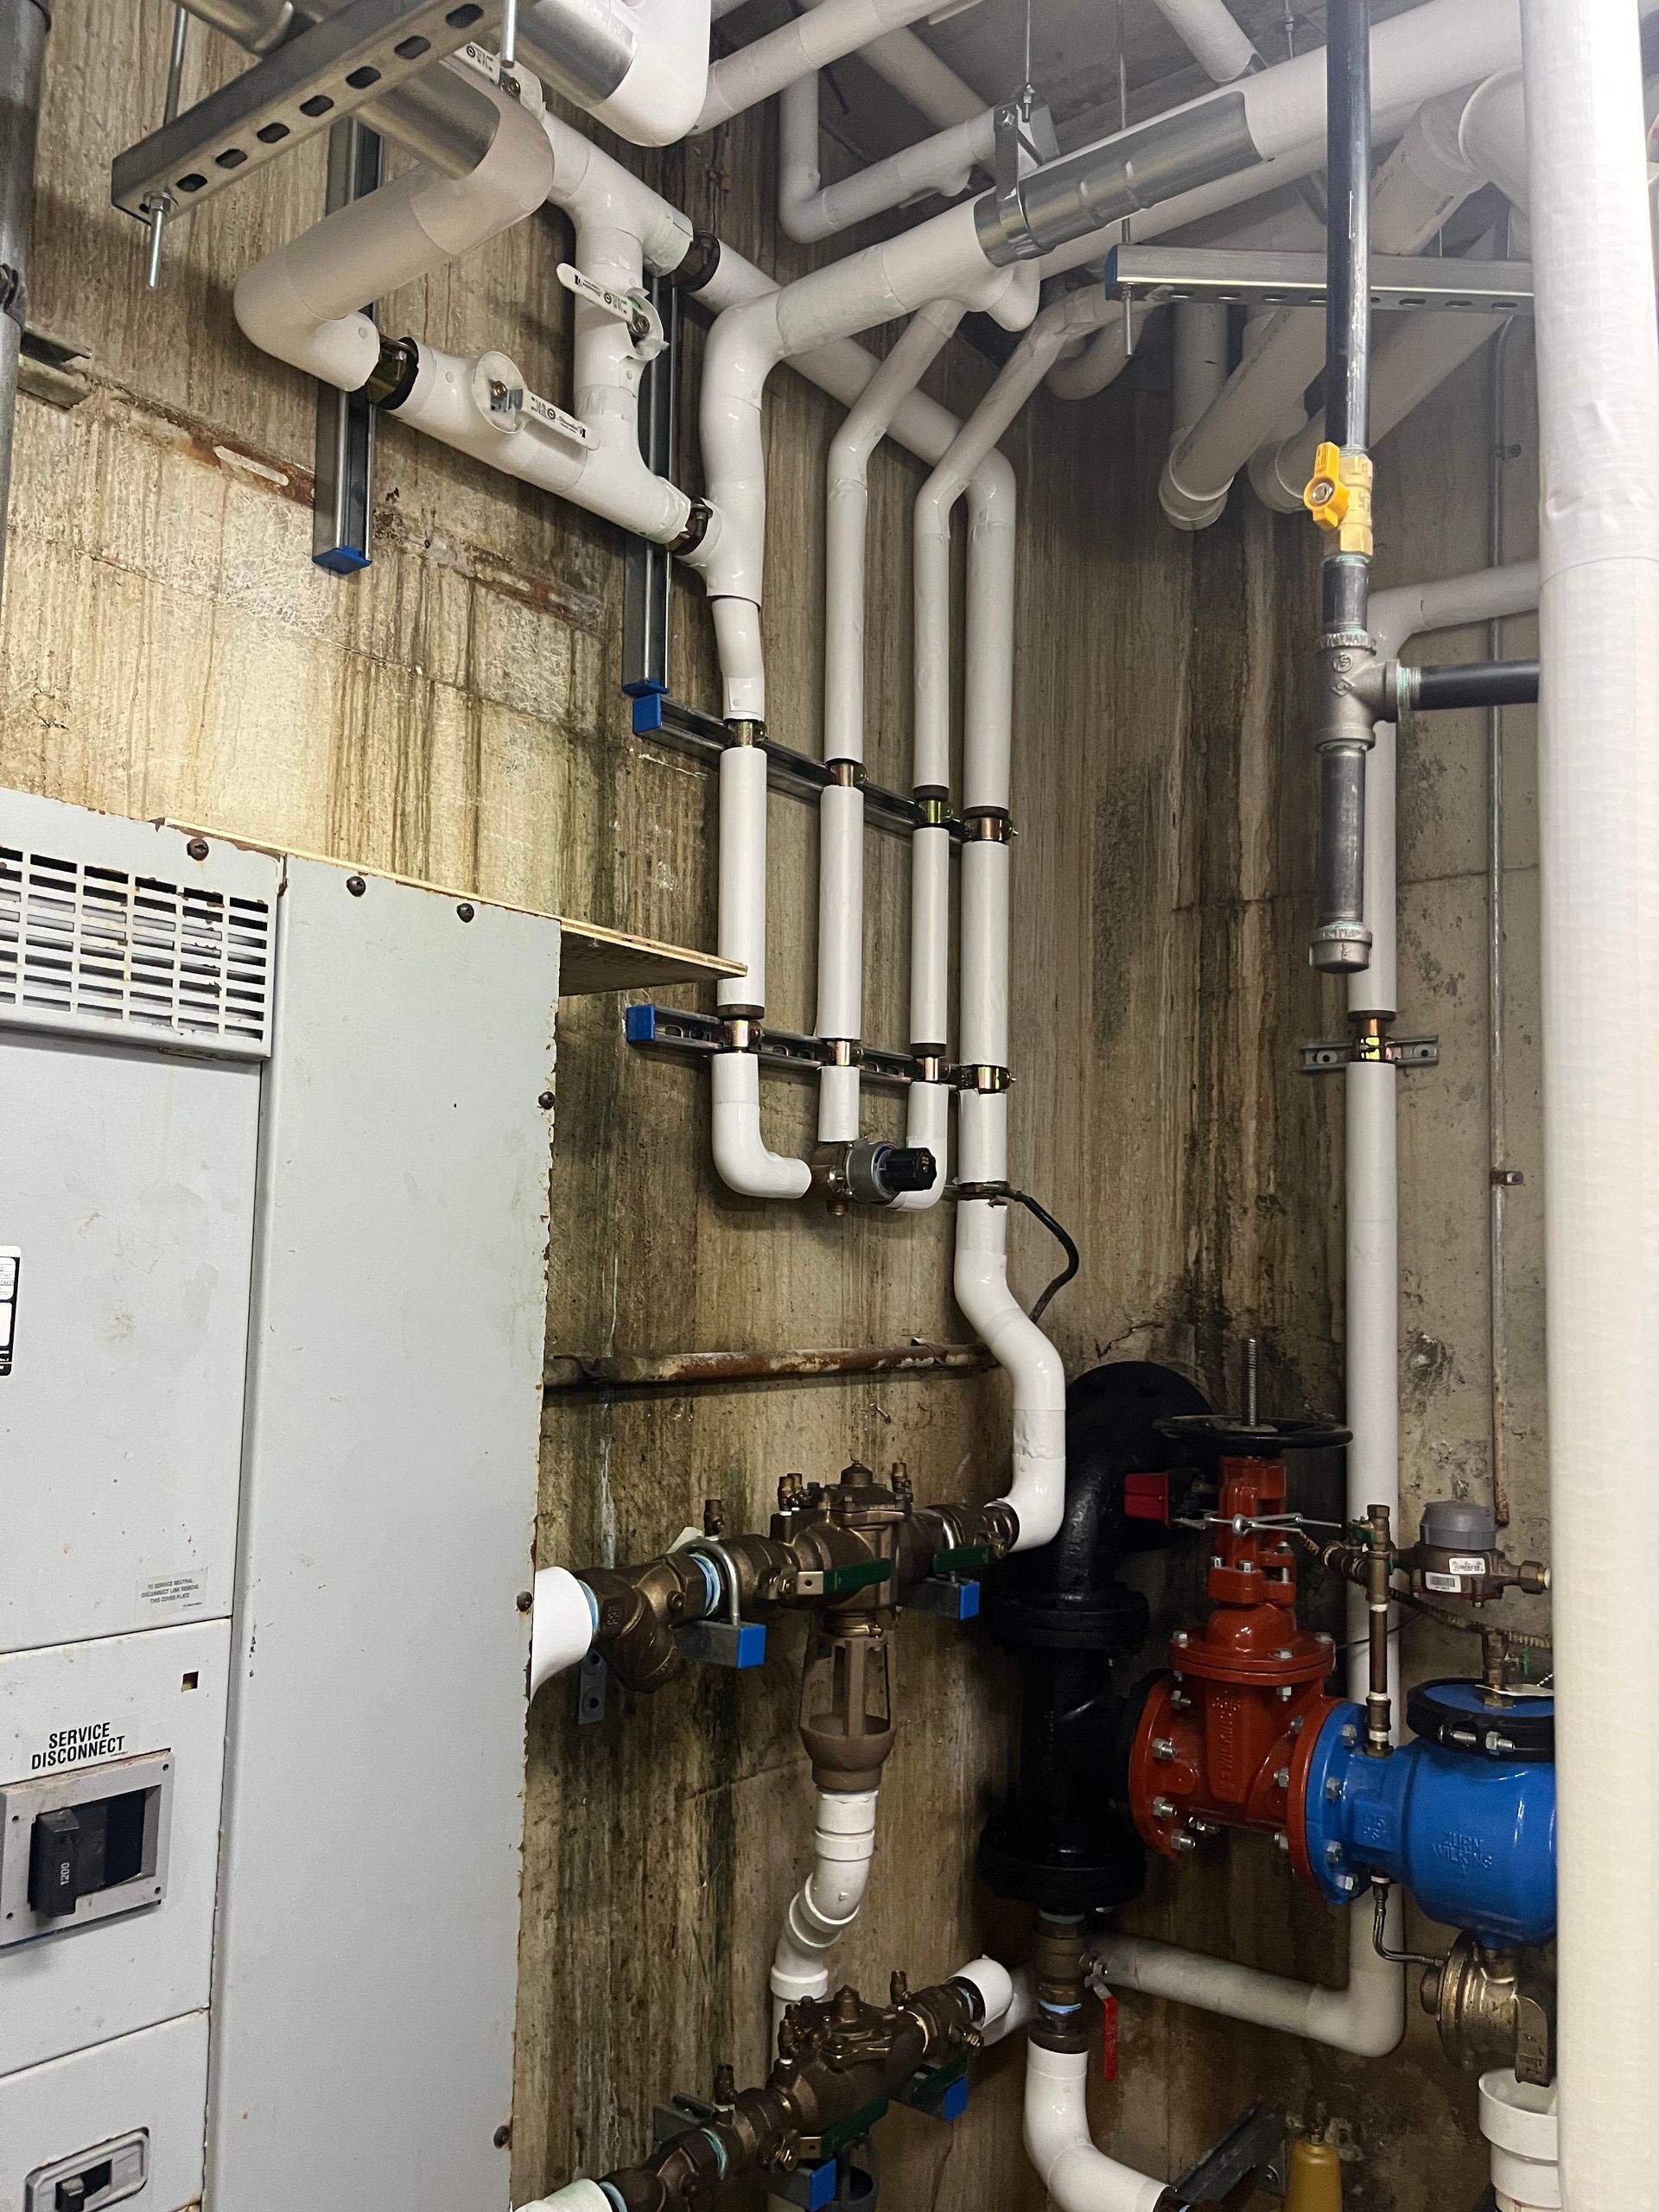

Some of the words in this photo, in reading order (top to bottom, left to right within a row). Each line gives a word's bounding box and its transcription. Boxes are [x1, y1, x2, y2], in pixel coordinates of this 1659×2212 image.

[48, 1722, 111, 1749] SERVICE
[31, 1735, 125, 1770] DISCONNECT
[60, 1862, 70, 1886] 1200
